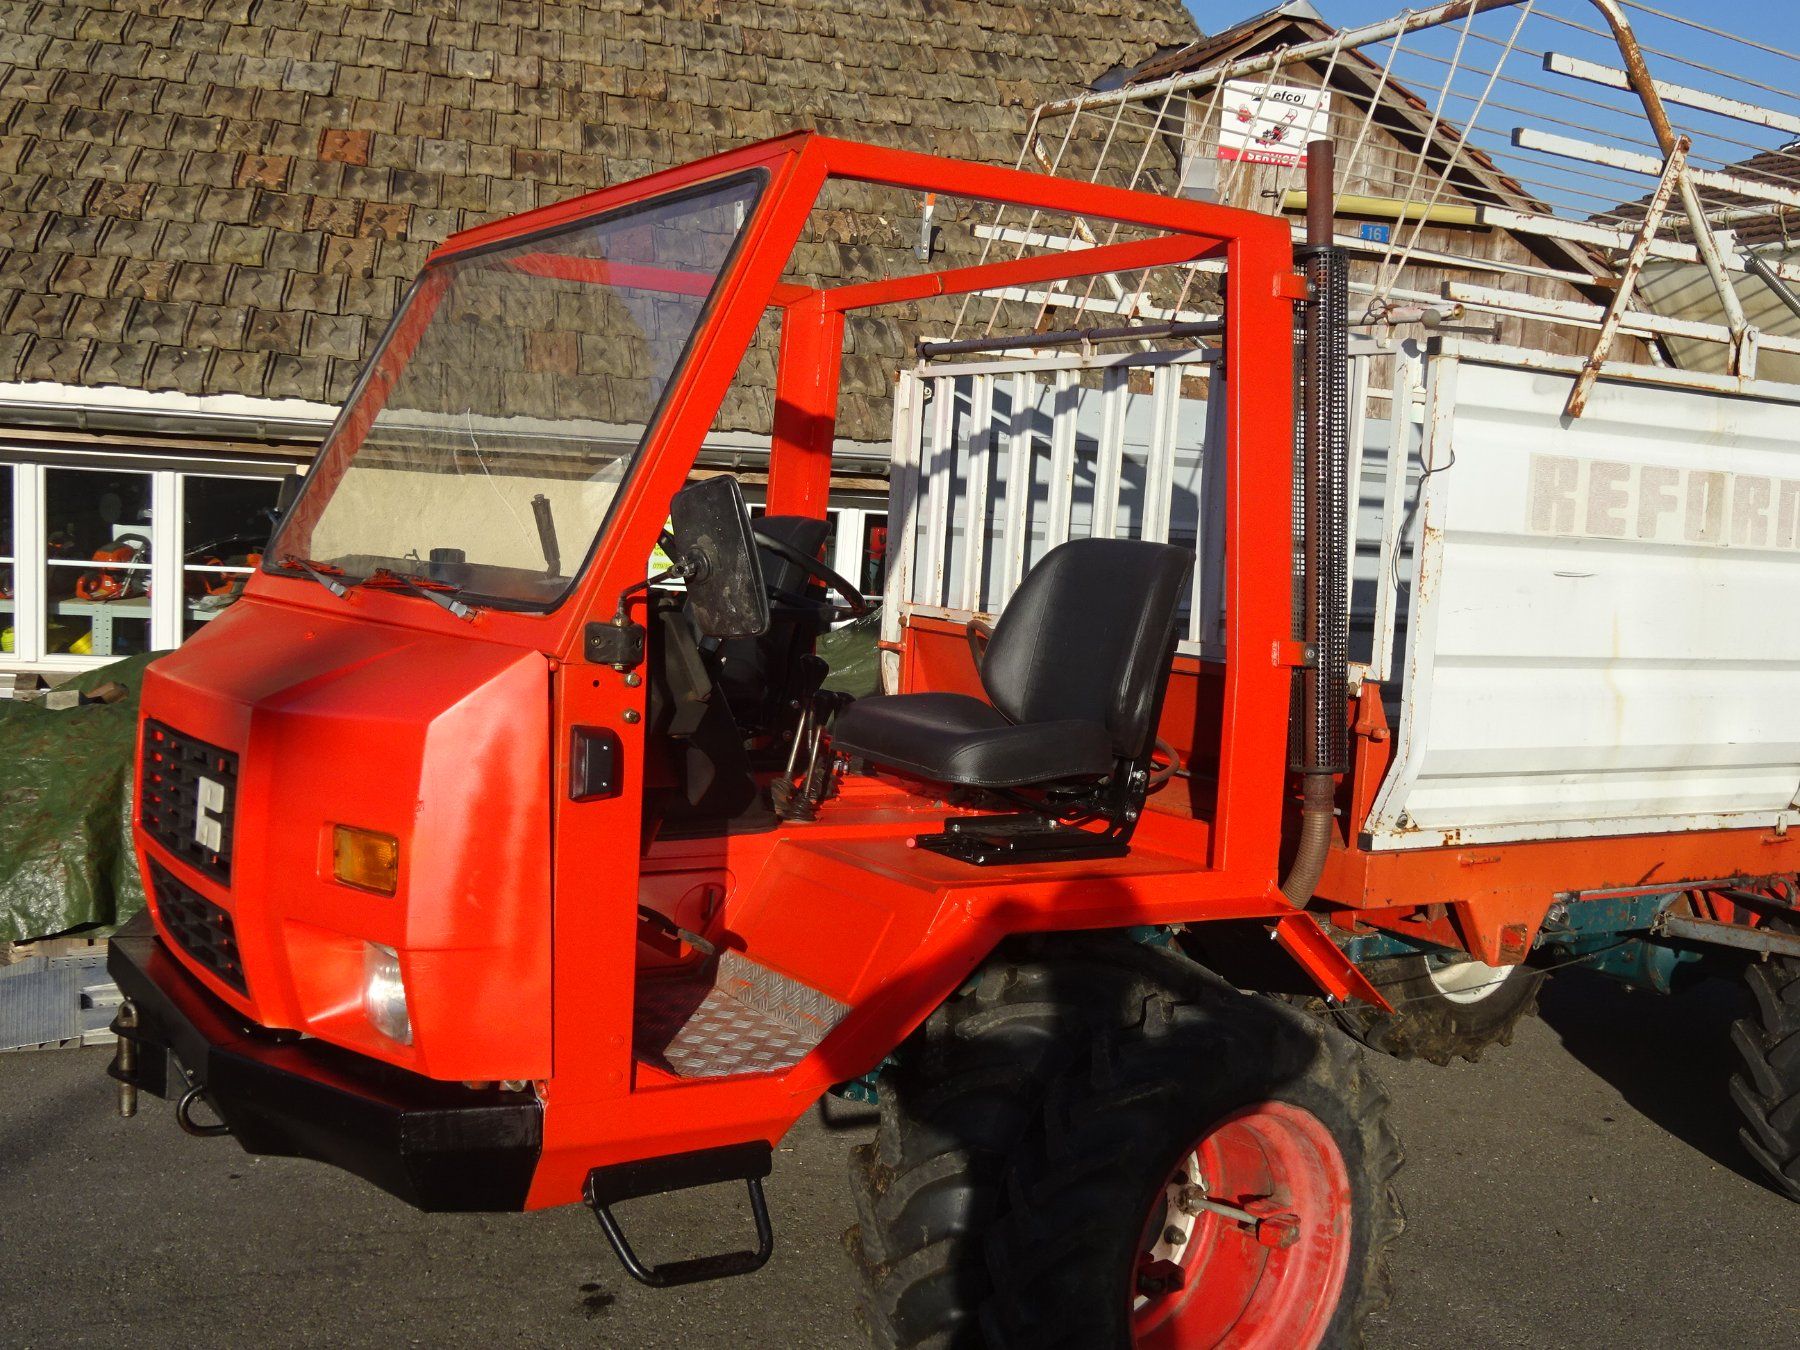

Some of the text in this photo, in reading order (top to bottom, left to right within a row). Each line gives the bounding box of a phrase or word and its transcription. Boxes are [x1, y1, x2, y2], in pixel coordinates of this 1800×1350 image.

[1273, 91, 1301, 103] efco
[1247, 151, 1298, 166] SERVICE
[1369, 227, 1382, 240] 16
